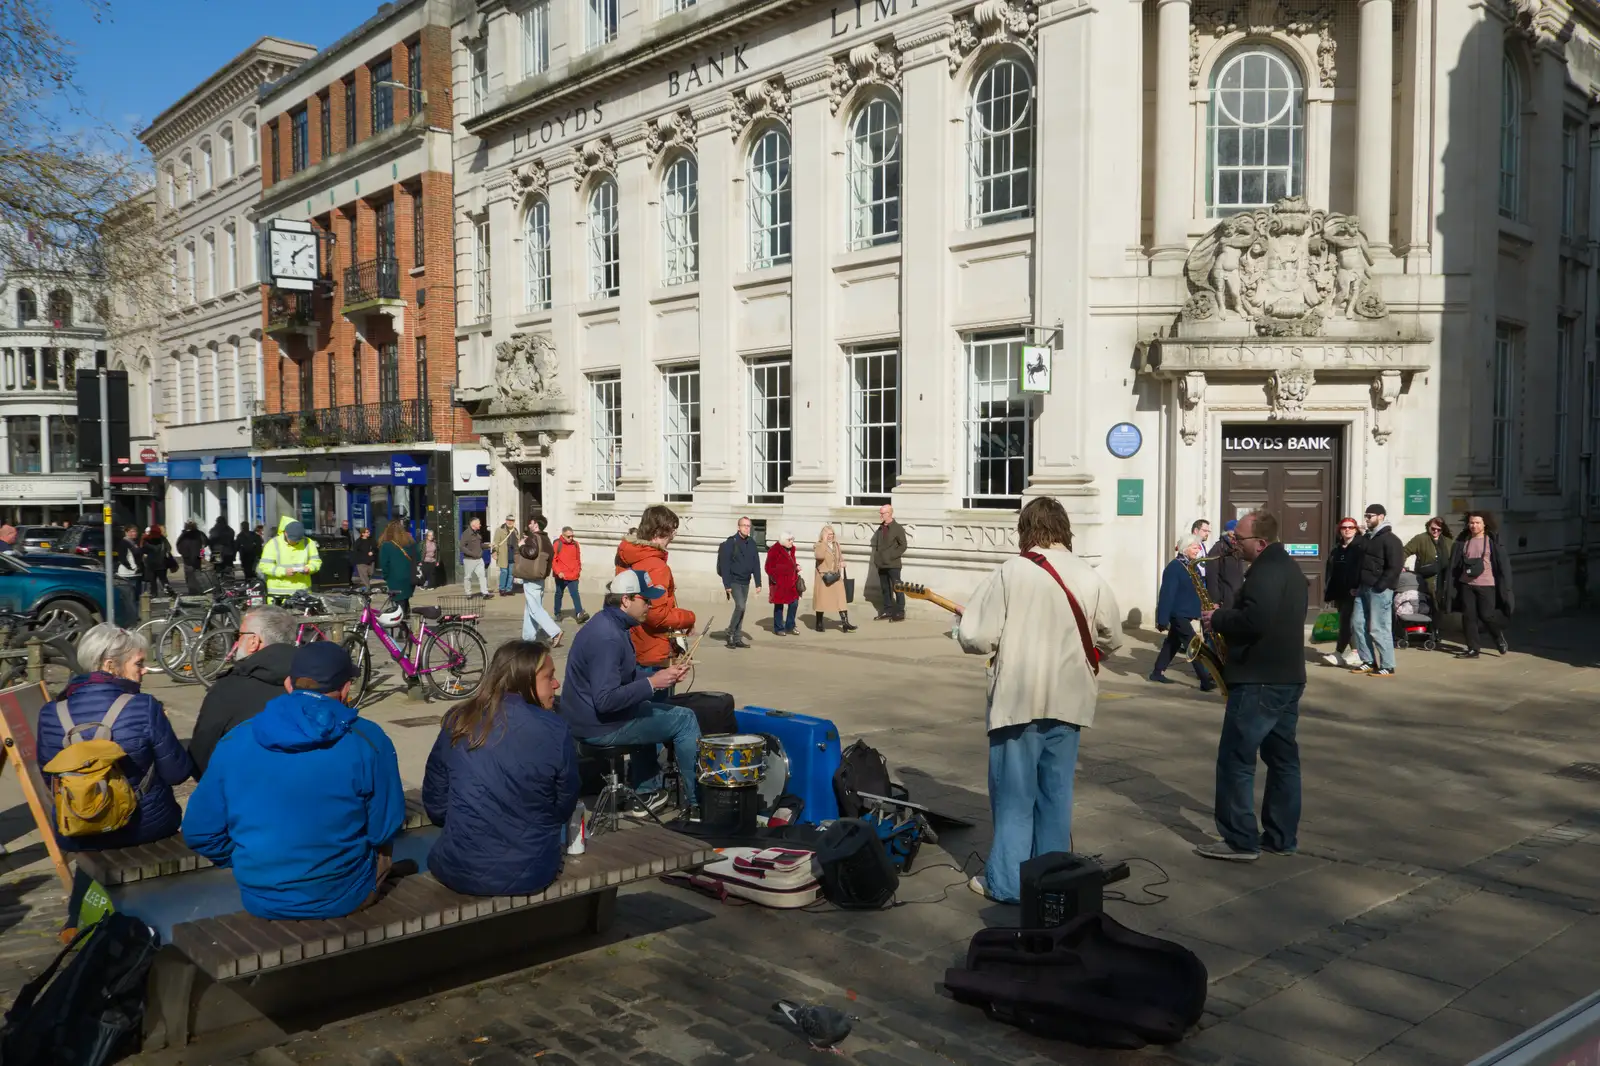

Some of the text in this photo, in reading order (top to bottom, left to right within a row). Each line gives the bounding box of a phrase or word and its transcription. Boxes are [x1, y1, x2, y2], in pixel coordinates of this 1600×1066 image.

[512, 0, 918, 156] LLOYDS BANK LIM
[1225, 436, 1331, 450] LLOYDS BANK
